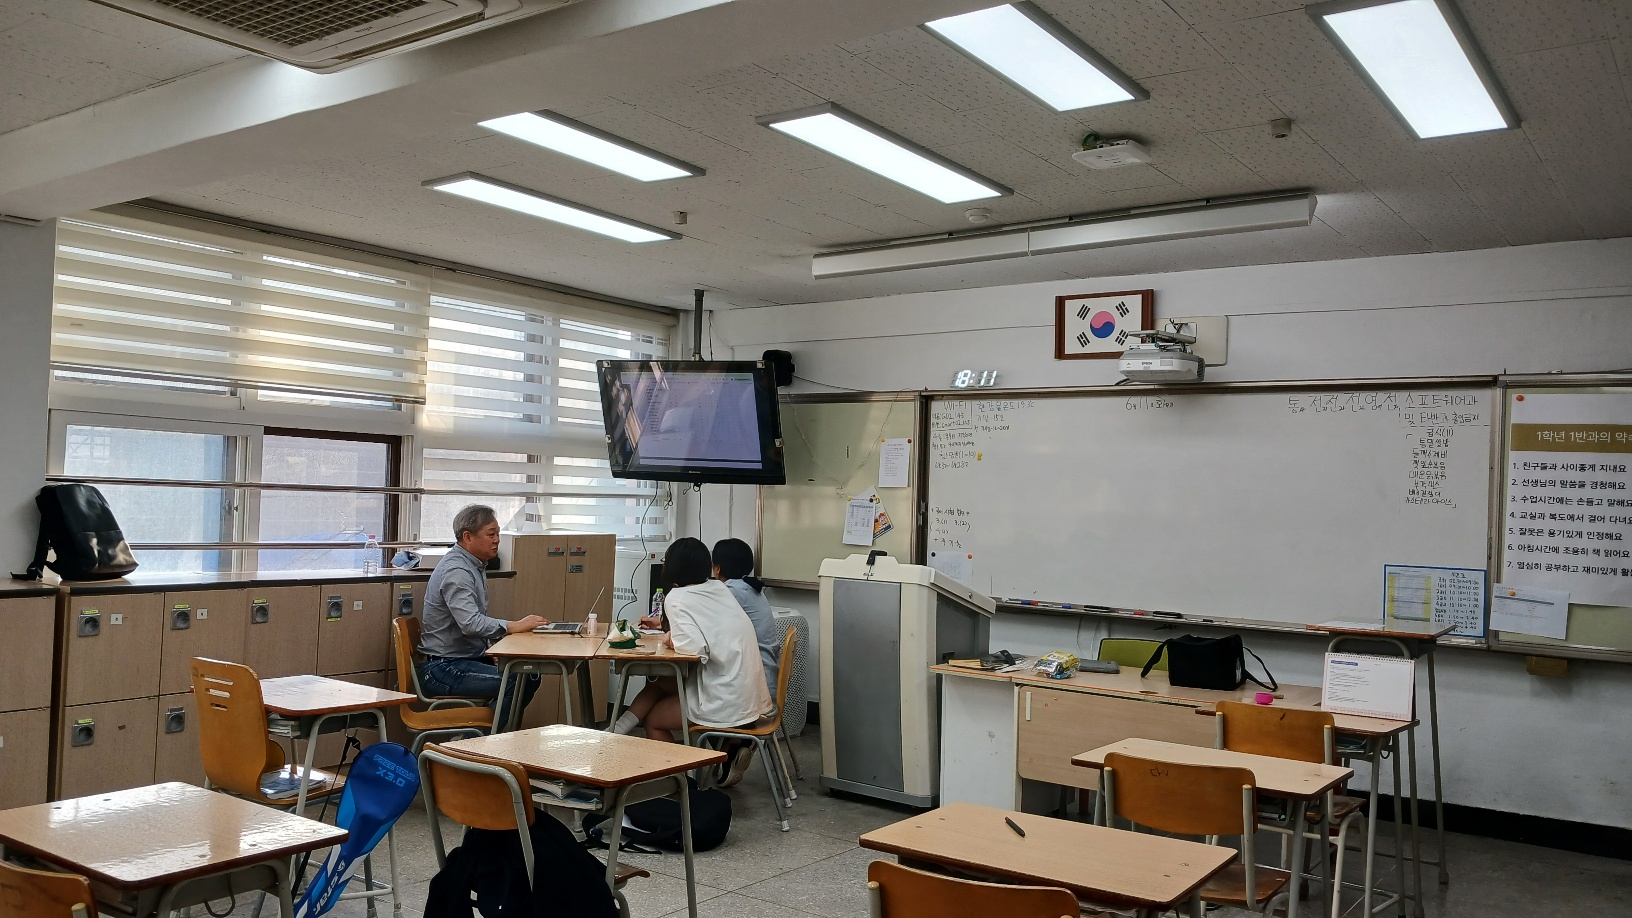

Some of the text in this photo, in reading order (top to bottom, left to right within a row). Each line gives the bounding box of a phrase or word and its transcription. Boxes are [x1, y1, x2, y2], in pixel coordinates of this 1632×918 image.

[1536, 430, 1565, 442] 1학년
[1570, 431, 1611, 443] 1반과의
[1523, 462, 1557, 471] 친구들과
[1560, 463, 1596, 472] 사이좋게
[1599, 464, 1627, 473] 지내요
[1522, 478, 1556, 488] 선생님의
[1560, 480, 1586, 489] 말씀을
[1590, 481, 1626, 490] 경청해요
[1520, 495, 1574, 505] 수업시간에는
[1576, 497, 1603, 506] 손들고
[1607, 498, 1632, 507] 말해요
[1519, 512, 1546, 520] 교실과
[1549, 513, 1584, 522] 복도에서
[1588, 514, 1605, 523] 걸어
[1519, 528, 1544, 536] 잘못은
[1548, 529, 1583, 539] 용기있게
[1587, 531, 1623, 541] 인정해요
[1518, 544, 1560, 554] 아침시간에
[1563, 546, 1588, 556] 조용히
[1604, 549, 1630, 558] 읽어요
[1517, 561, 1542, 570] 열심히
[1545, 563, 1579, 573] 공부하고
[1582, 566, 1618, 576] 재미있게
